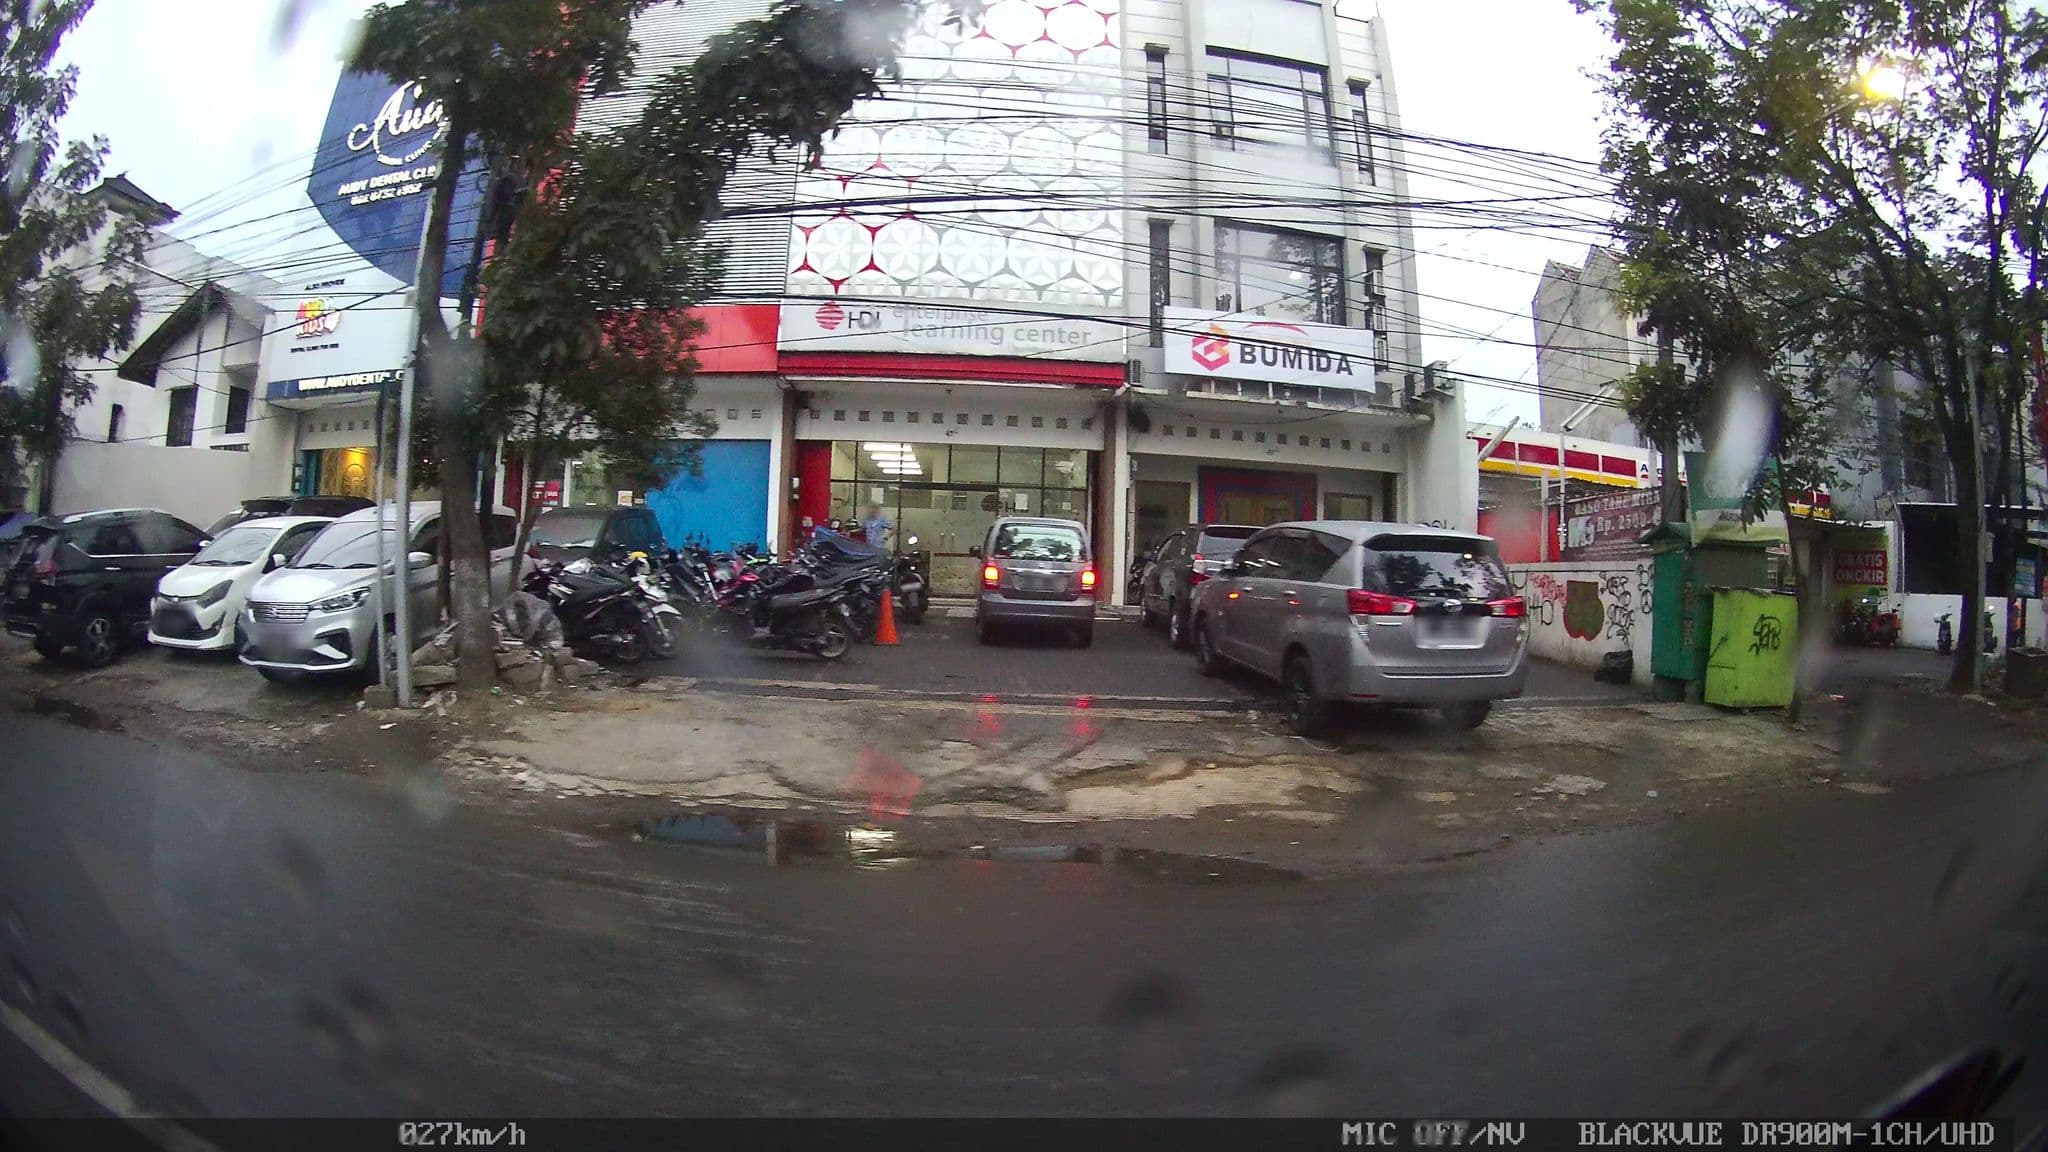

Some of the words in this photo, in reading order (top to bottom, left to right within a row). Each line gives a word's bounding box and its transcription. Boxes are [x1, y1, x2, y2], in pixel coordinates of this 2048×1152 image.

[369, 171, 412, 188] DENTAL
[892, 304, 989, 322] enterprise
[903, 319, 1005, 345] learning
[1013, 324, 1092, 346] center
[1239, 343, 1354, 376] BUMIDA
